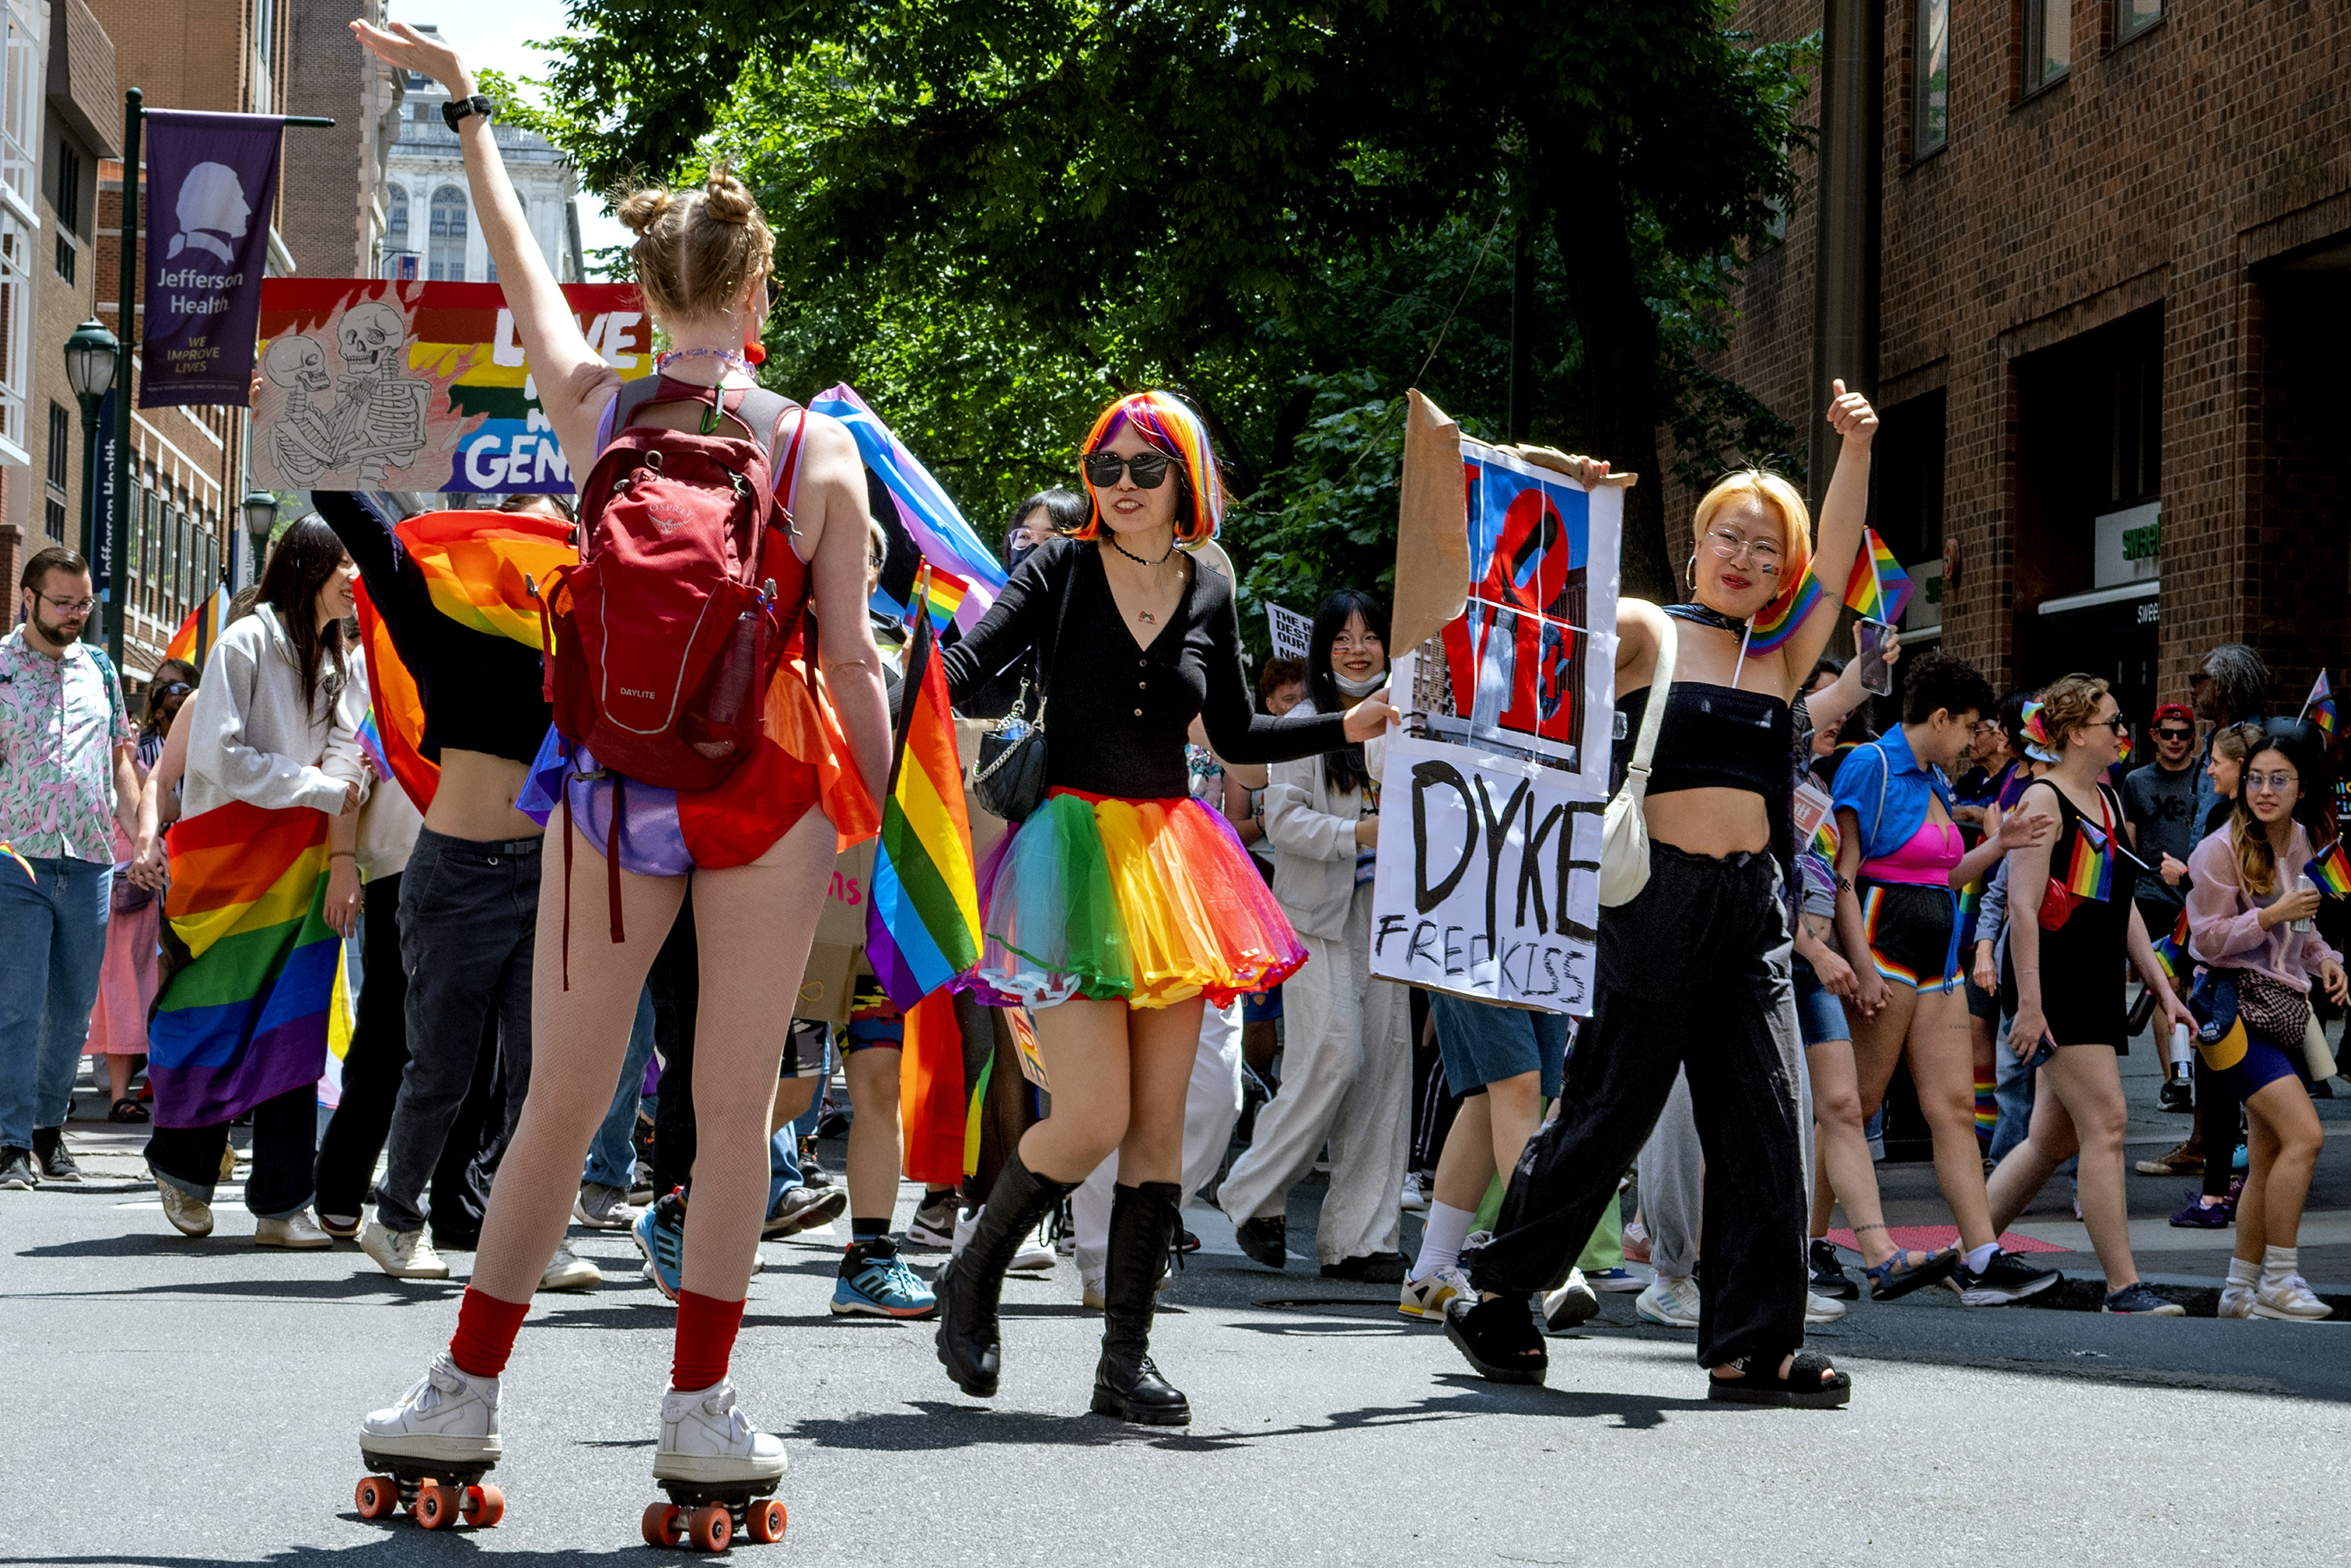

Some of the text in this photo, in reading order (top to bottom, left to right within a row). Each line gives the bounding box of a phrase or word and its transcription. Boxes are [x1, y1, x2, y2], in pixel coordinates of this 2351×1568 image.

[158, 268, 243, 289] Jefferson
[170, 295, 229, 313] Health
[188, 336, 207, 347] WE
[493, 309, 643, 368] LVE
[167, 347, 220, 360] IMPROVE
[176, 360, 207, 374] LIVES
[465, 435, 574, 490] GEN
[649, 504, 694, 517] OSPREY
[2121, 513, 2161, 561] sweet
[1273, 608, 1300, 629] THE
[2136, 602, 2160, 625] swee
[1276, 619, 1312, 643] DEST
[1277, 632, 1306, 652] OUR
[619, 686, 656, 700] DAYLITE
[1411, 759, 1607, 962] DYKE
[828, 870, 863, 906] ns
